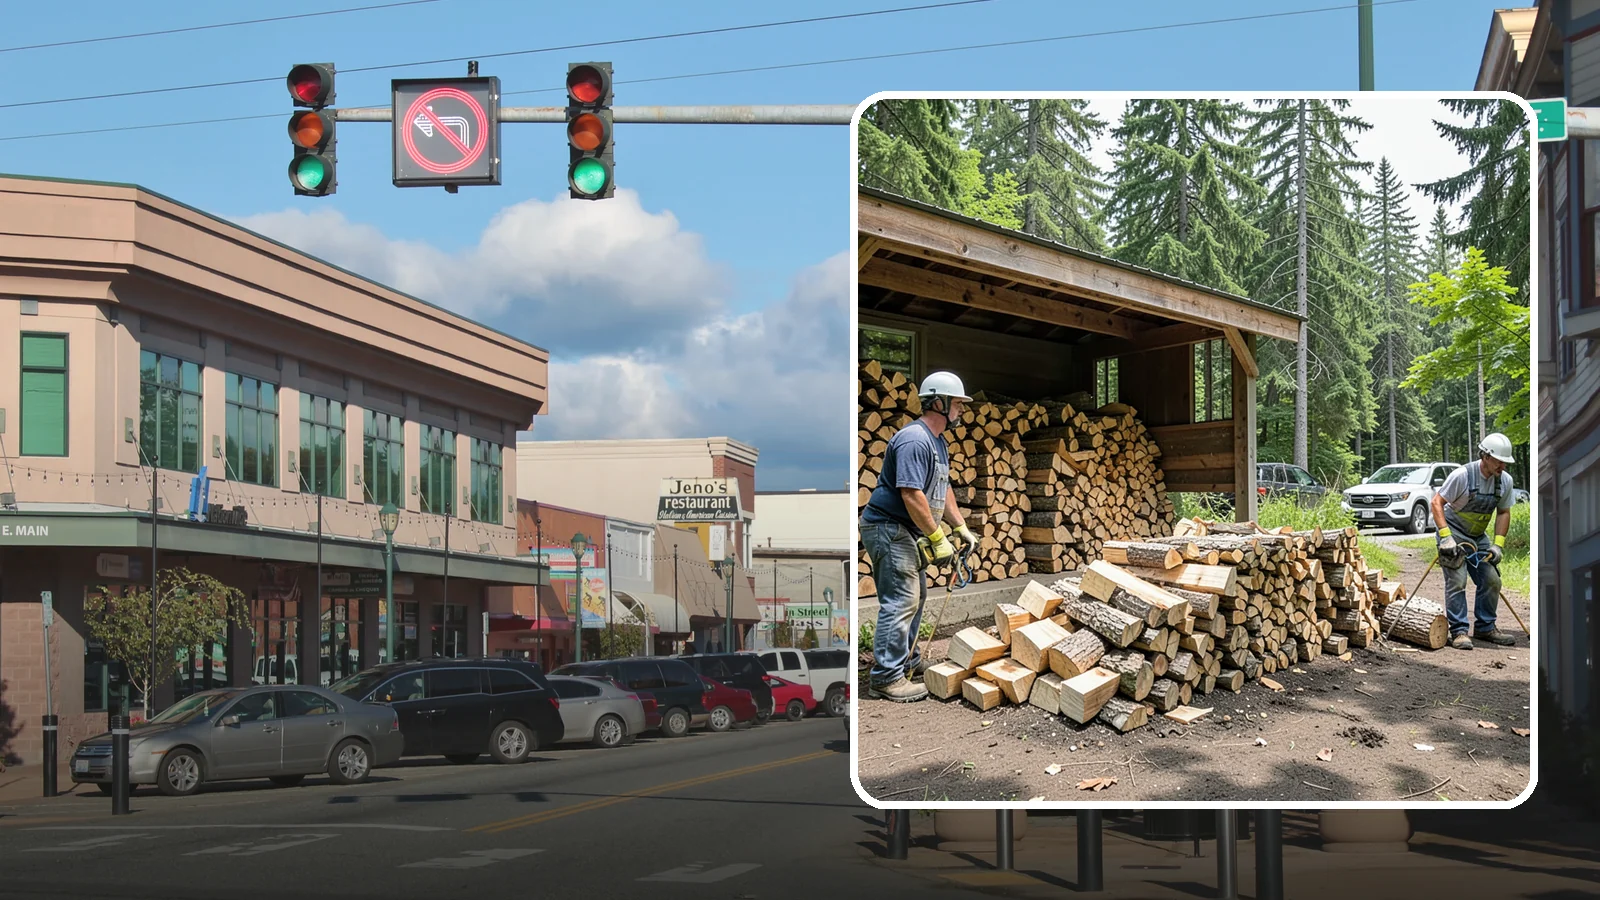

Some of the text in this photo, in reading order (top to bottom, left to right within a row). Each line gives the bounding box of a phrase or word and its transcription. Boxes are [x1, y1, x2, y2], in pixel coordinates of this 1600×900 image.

[670, 480, 727, 494] Jeno's
[665, 497, 731, 509] restaurant
[659, 510, 681, 519] Italian
[686, 510, 714, 519] American
[715, 510, 737, 519] Cuisine
[2, 525, 49, 536] E. MAIN
[797, 607, 828, 617] Street
